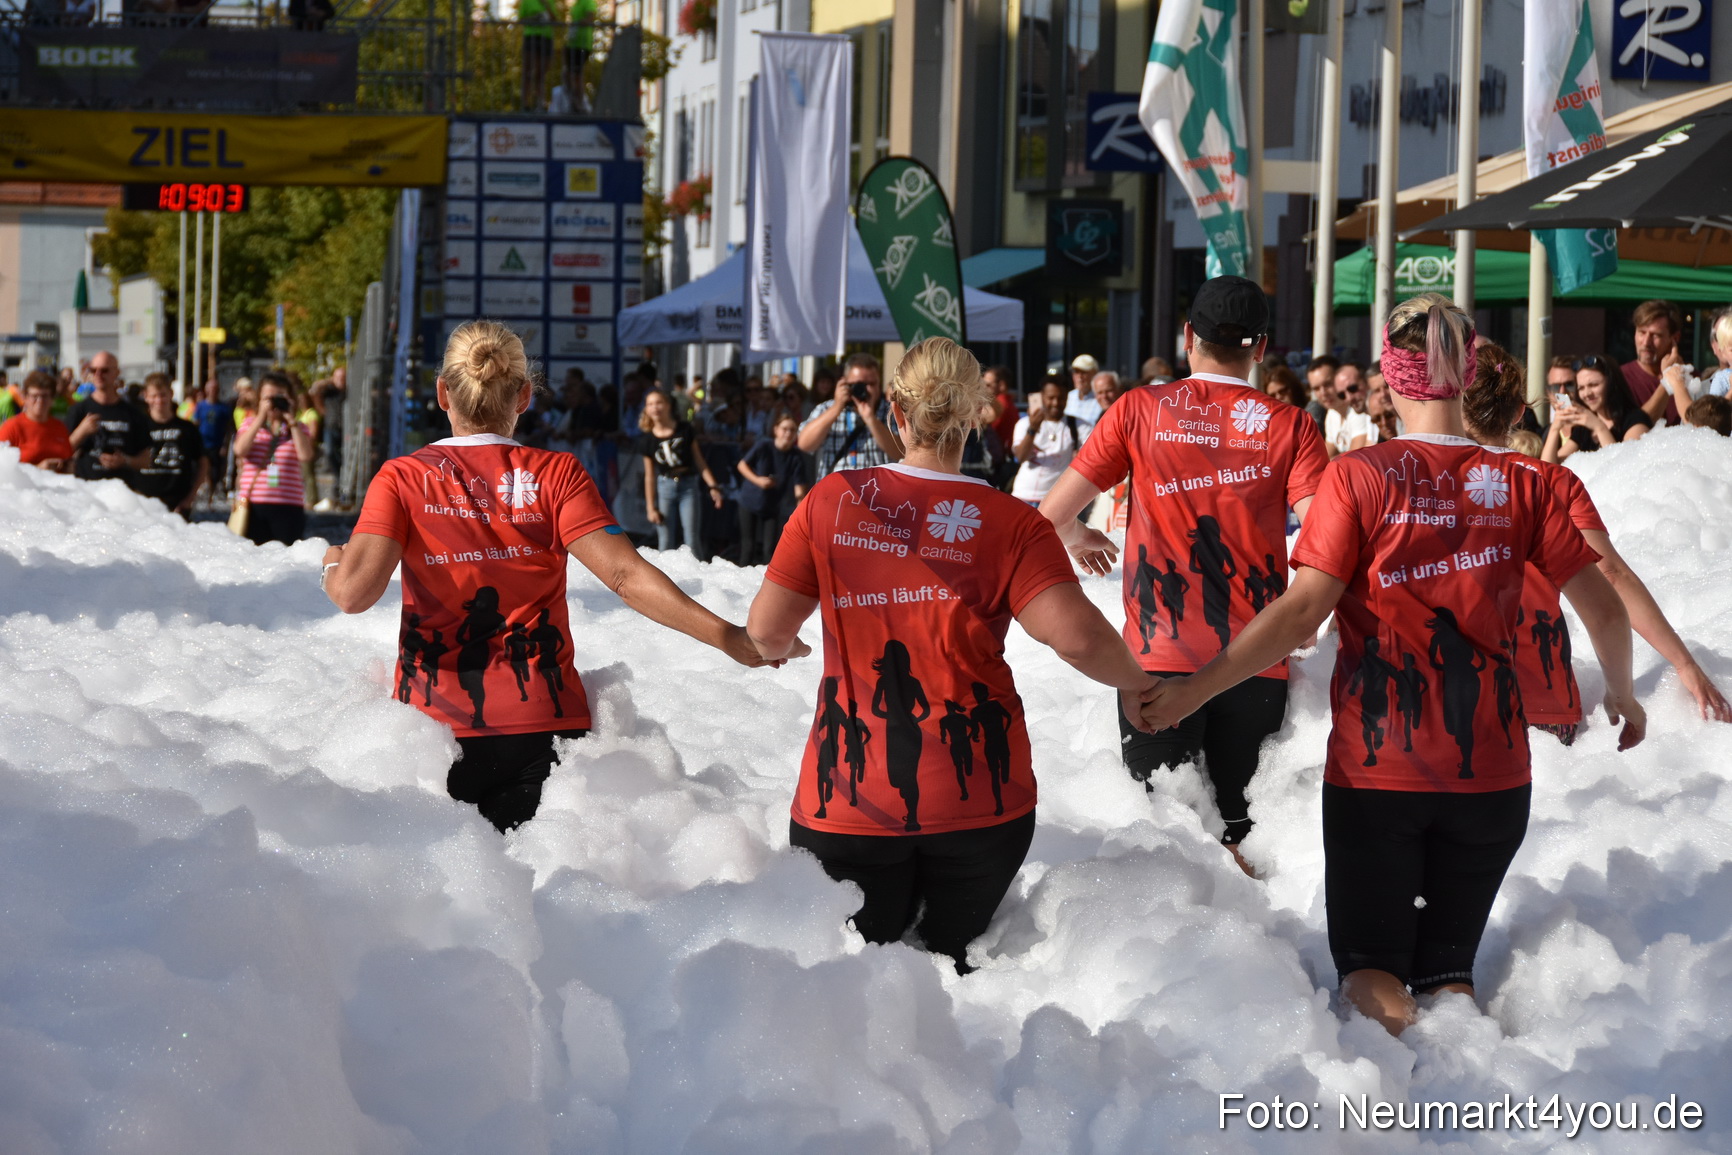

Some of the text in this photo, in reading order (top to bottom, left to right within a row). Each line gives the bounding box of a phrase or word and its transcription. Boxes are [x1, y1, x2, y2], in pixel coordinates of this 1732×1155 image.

[37, 46, 137, 67] BOCK
[130, 127, 246, 168] ZIEL
[846, 305, 882, 318] Drive
[1177, 419, 1220, 432] caritas
[1155, 430, 1219, 448] nürnberg
[1229, 438, 1269, 451] caritas
[1154, 478, 1179, 497] bei
[1182, 475, 1213, 490] uns
[1409, 495, 1455, 509] caritas
[425, 503, 491, 524] nürnberg
[499, 511, 544, 523] caritas
[1385, 510, 1456, 528] nürnberg
[1466, 513, 1512, 527] caritas
[858, 520, 912, 539] caritas
[833, 531, 909, 558] nürnberg
[424, 551, 448, 566] bei
[453, 549, 483, 562] uns
[920, 546, 972, 563] caritas
[1377, 564, 1407, 588] bei
[1413, 560, 1449, 579] uns
[857, 591, 888, 608] uns
